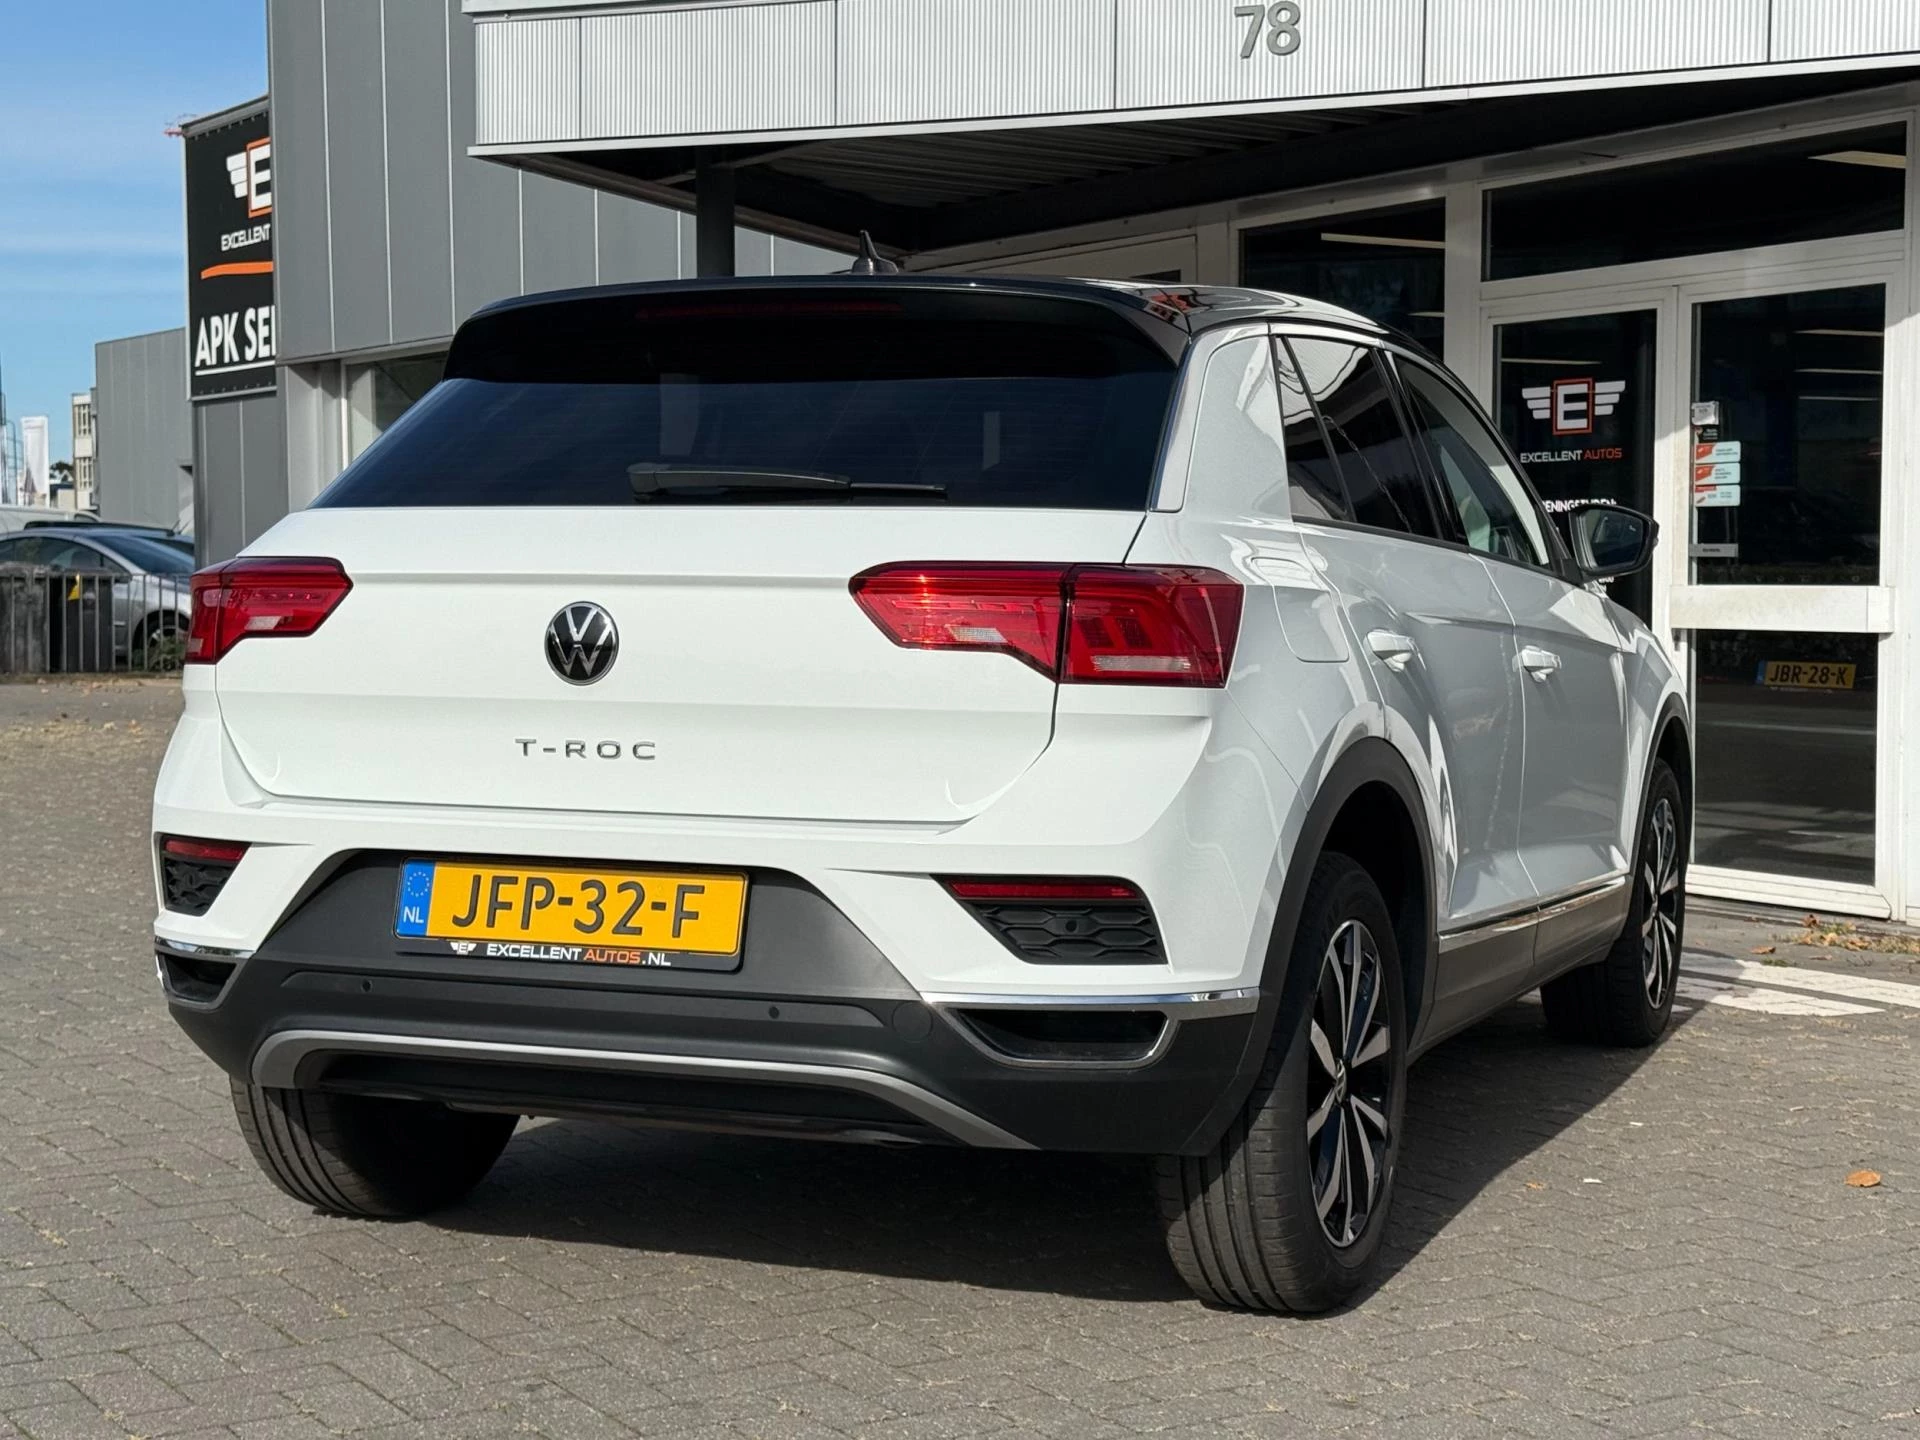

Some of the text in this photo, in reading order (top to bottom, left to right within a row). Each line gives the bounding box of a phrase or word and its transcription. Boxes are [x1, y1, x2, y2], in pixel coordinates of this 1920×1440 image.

[1234, 1, 1301, 59] 78
[221, 223, 271, 251] EXCELLENT
[195, 311, 240, 367] APK
[1556, 383, 1588, 430] E
[1520, 448, 1622, 463] EXCELLENT AUTOS
[1770, 664, 1848, 686] JBR-28-K
[515, 738, 656, 760] T-ROC
[403, 906, 424, 923] NL
[452, 874, 705, 938] JFP-32-F
[486, 943, 582, 961] EXCELLENT
